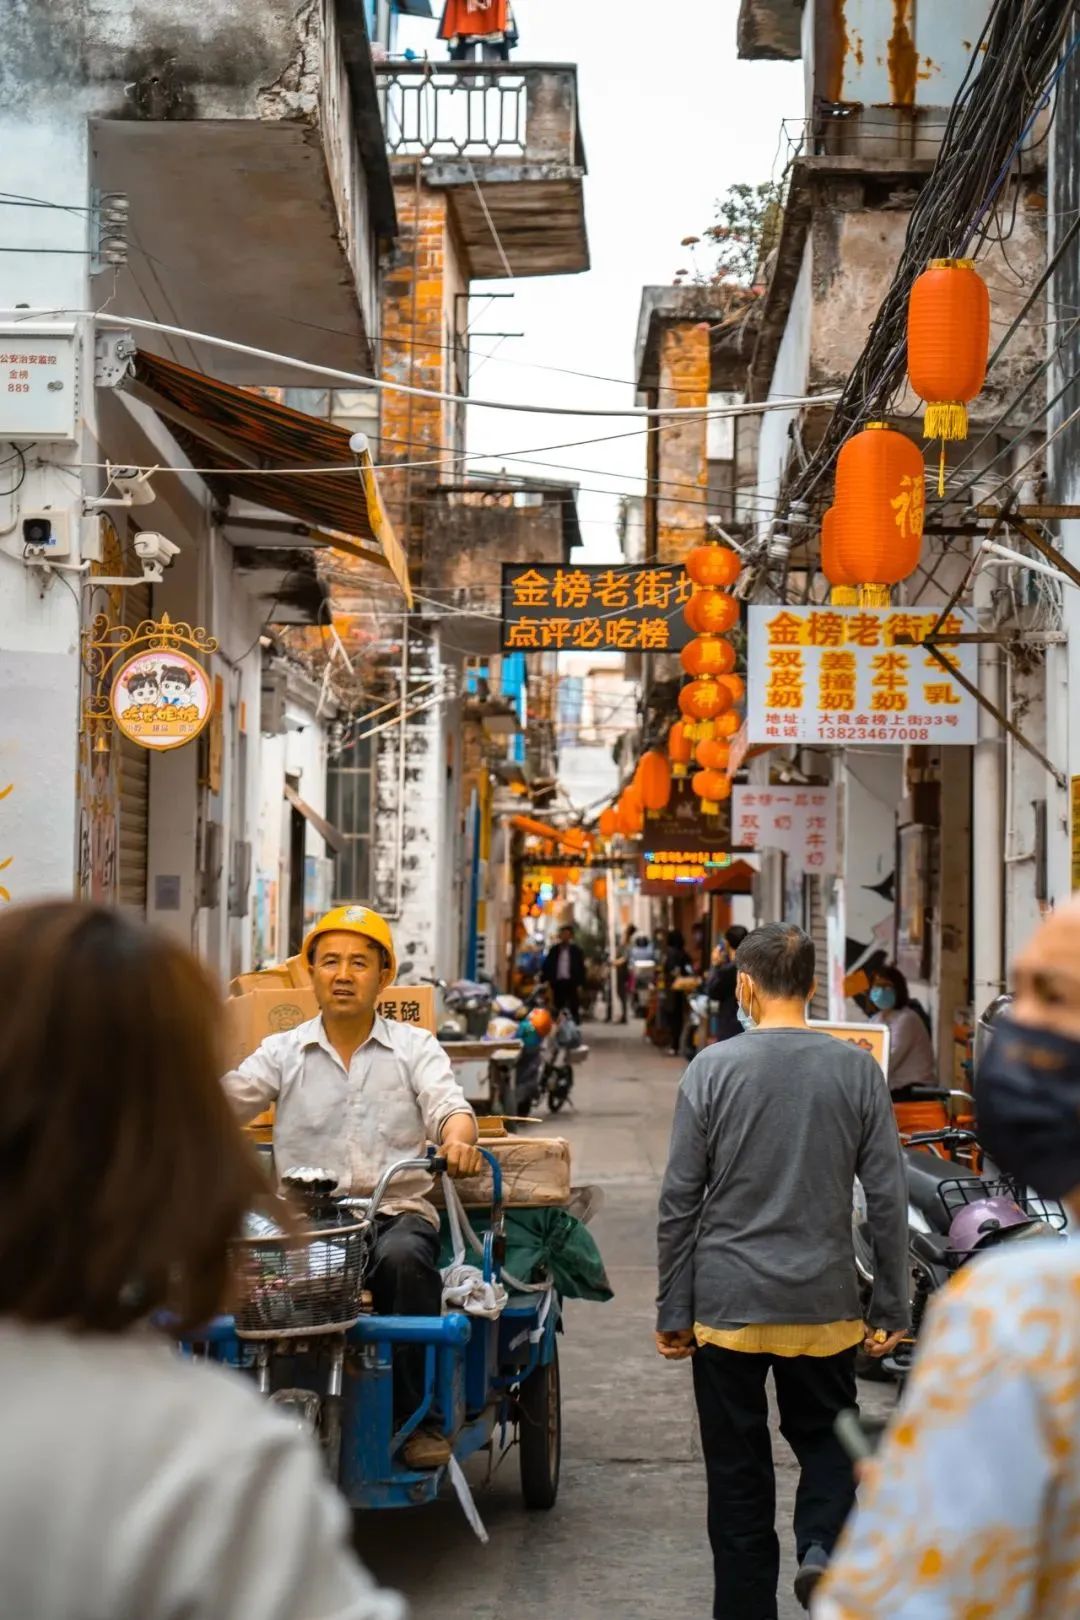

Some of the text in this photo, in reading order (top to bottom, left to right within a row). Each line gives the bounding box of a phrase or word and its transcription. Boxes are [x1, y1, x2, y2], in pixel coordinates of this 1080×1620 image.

[8, 383, 29, 392] 889
[504, 615, 670, 649] 点评必吃榜
[766, 650, 805, 708] 双皮奶
[818, 652, 856, 711] 姜撞奶
[868, 653, 911, 711] 水牛奶
[817, 727, 929, 741] 13823467008
